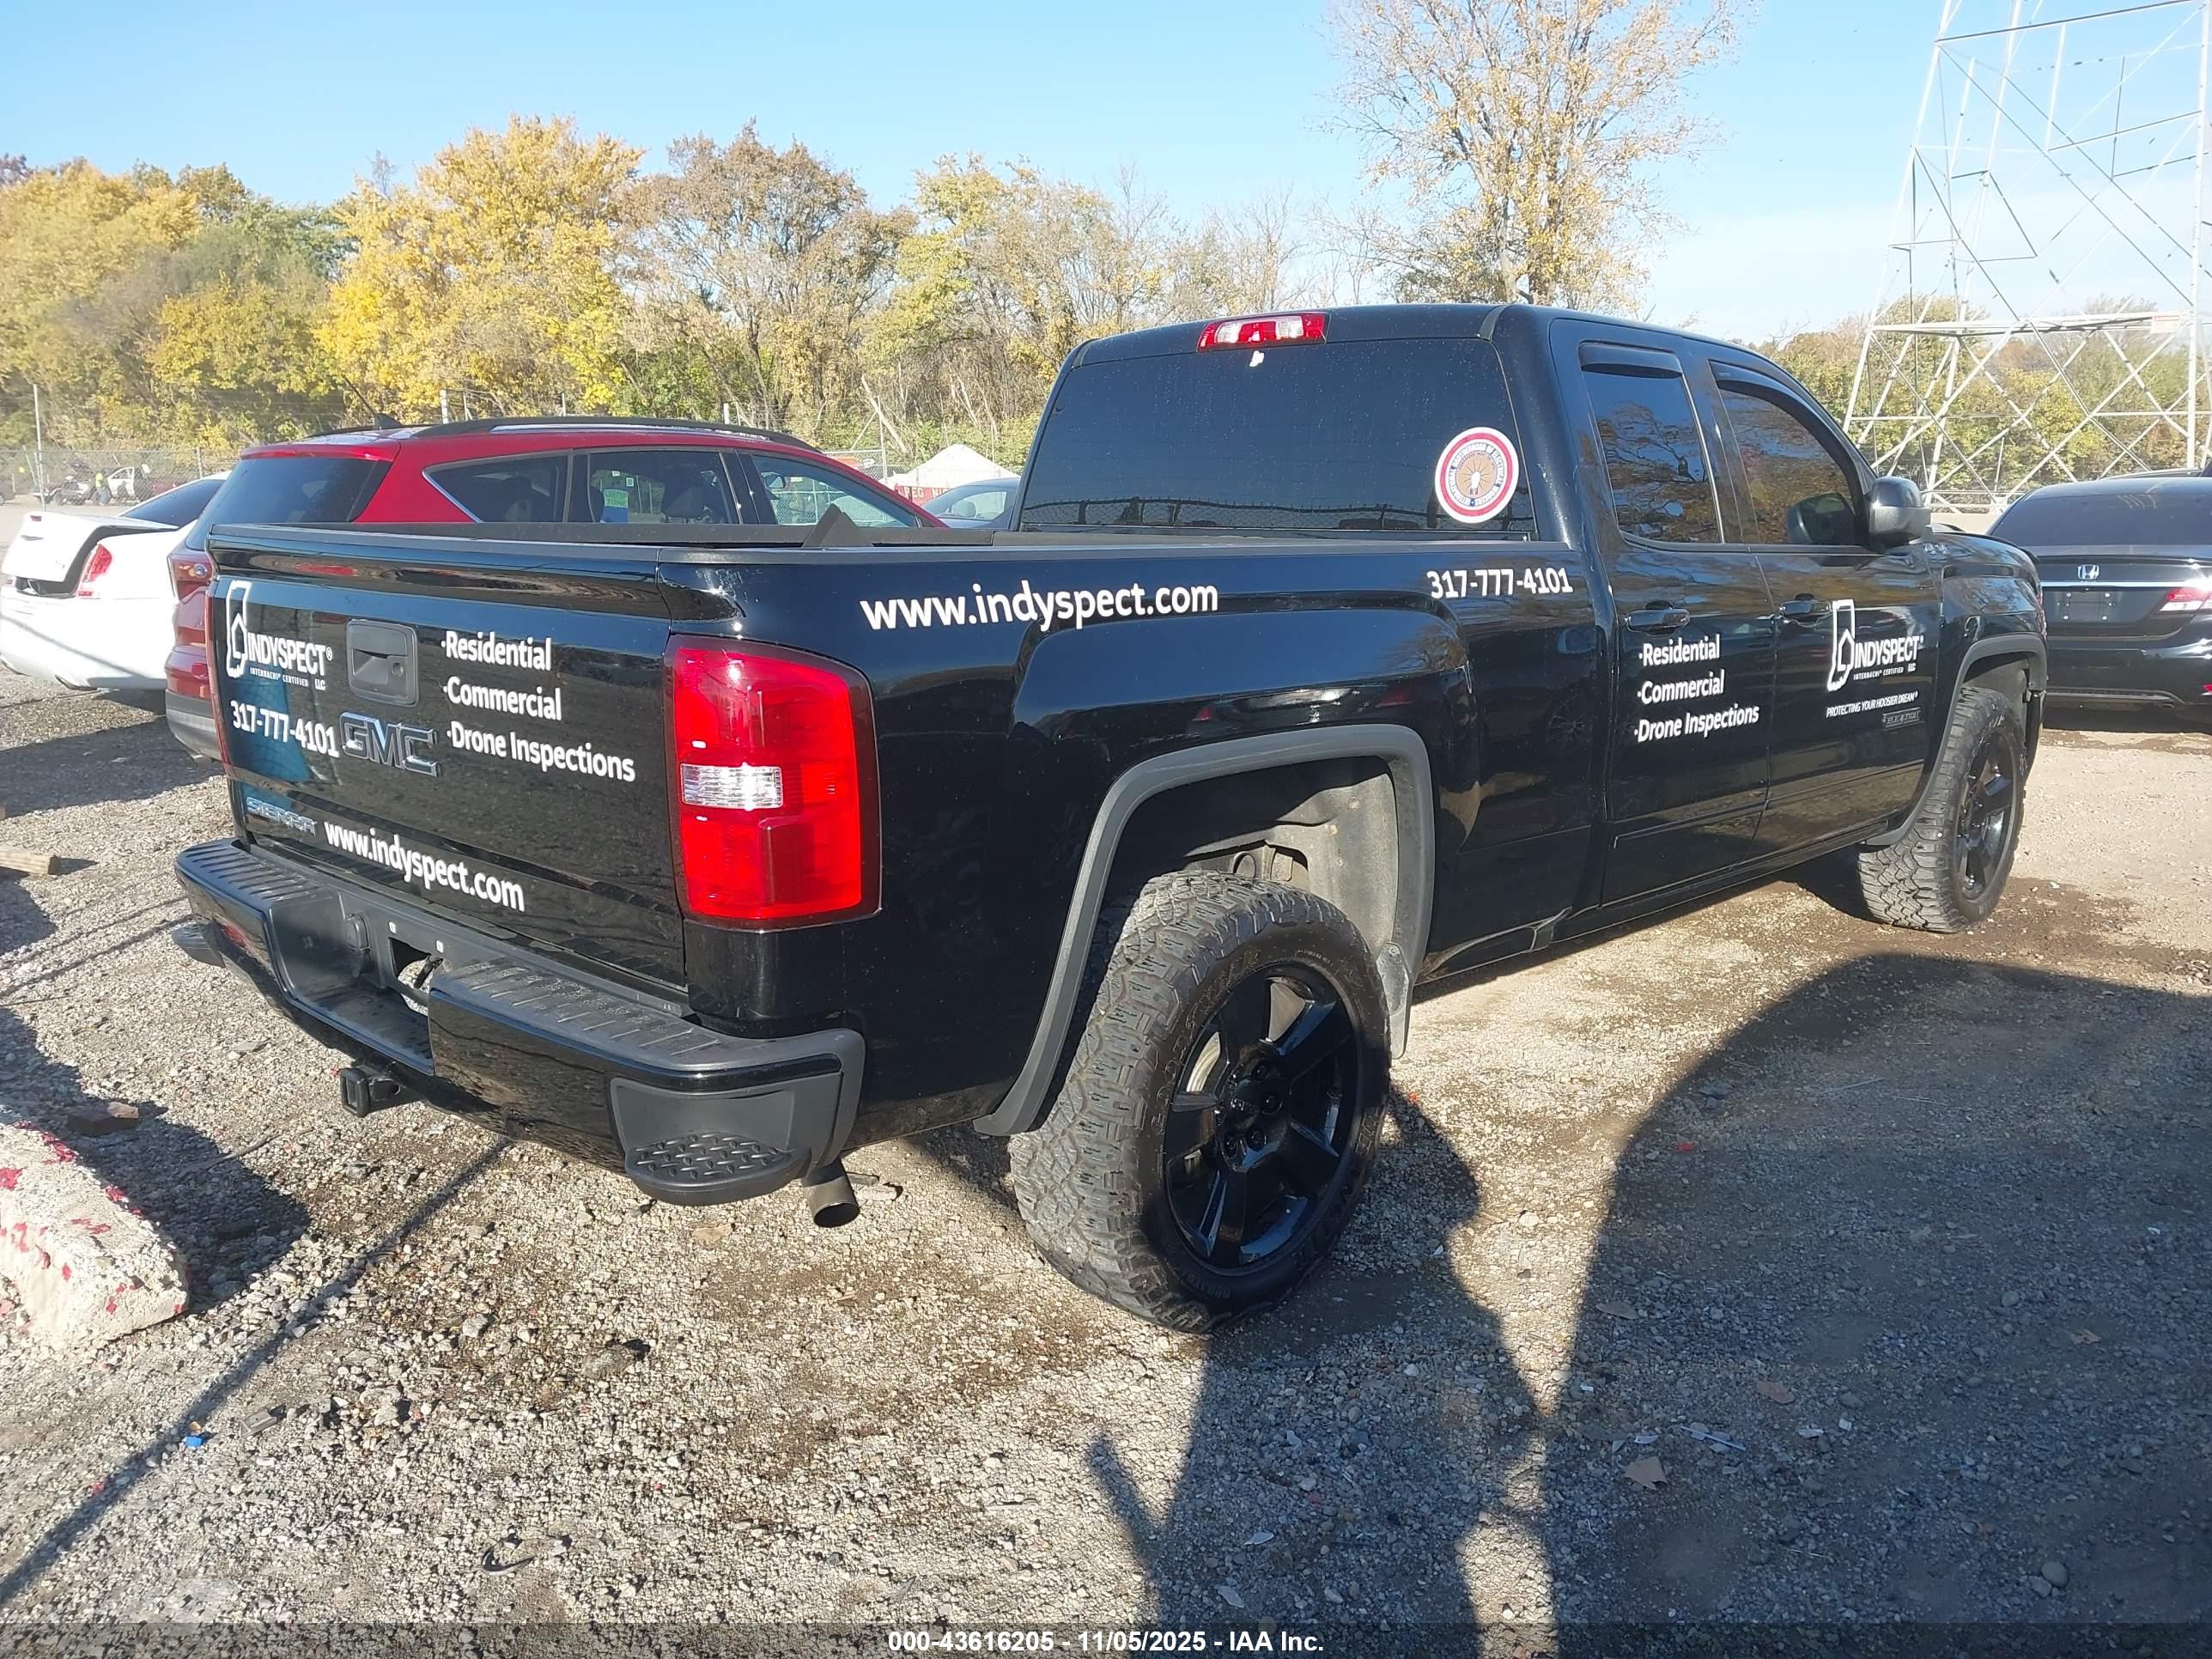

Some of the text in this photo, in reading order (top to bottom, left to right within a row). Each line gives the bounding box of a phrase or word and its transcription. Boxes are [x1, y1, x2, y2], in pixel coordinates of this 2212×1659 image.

[1427, 567, 1573, 599] 317-777-4101
[860, 580, 1218, 632] www.indyspect.com
[447, 630, 551, 671] Residential
[1644, 634, 1720, 666] Residential
[447, 676, 562, 722] Commercial
[1641, 669, 1724, 704] Commercial
[1826, 702, 1862, 718] PROTECTING
[1862, 700, 1876, 712] YOUR
[1875, 695, 1899, 708] HOOSIER
[230, 700, 340, 758] 317-777-4101
[1638, 703, 1759, 742] Drone Inspections
[339, 712, 440, 777] GMC
[452, 720, 635, 782] Drone Inspections
[324, 821, 525, 911] www.indyspect.com
